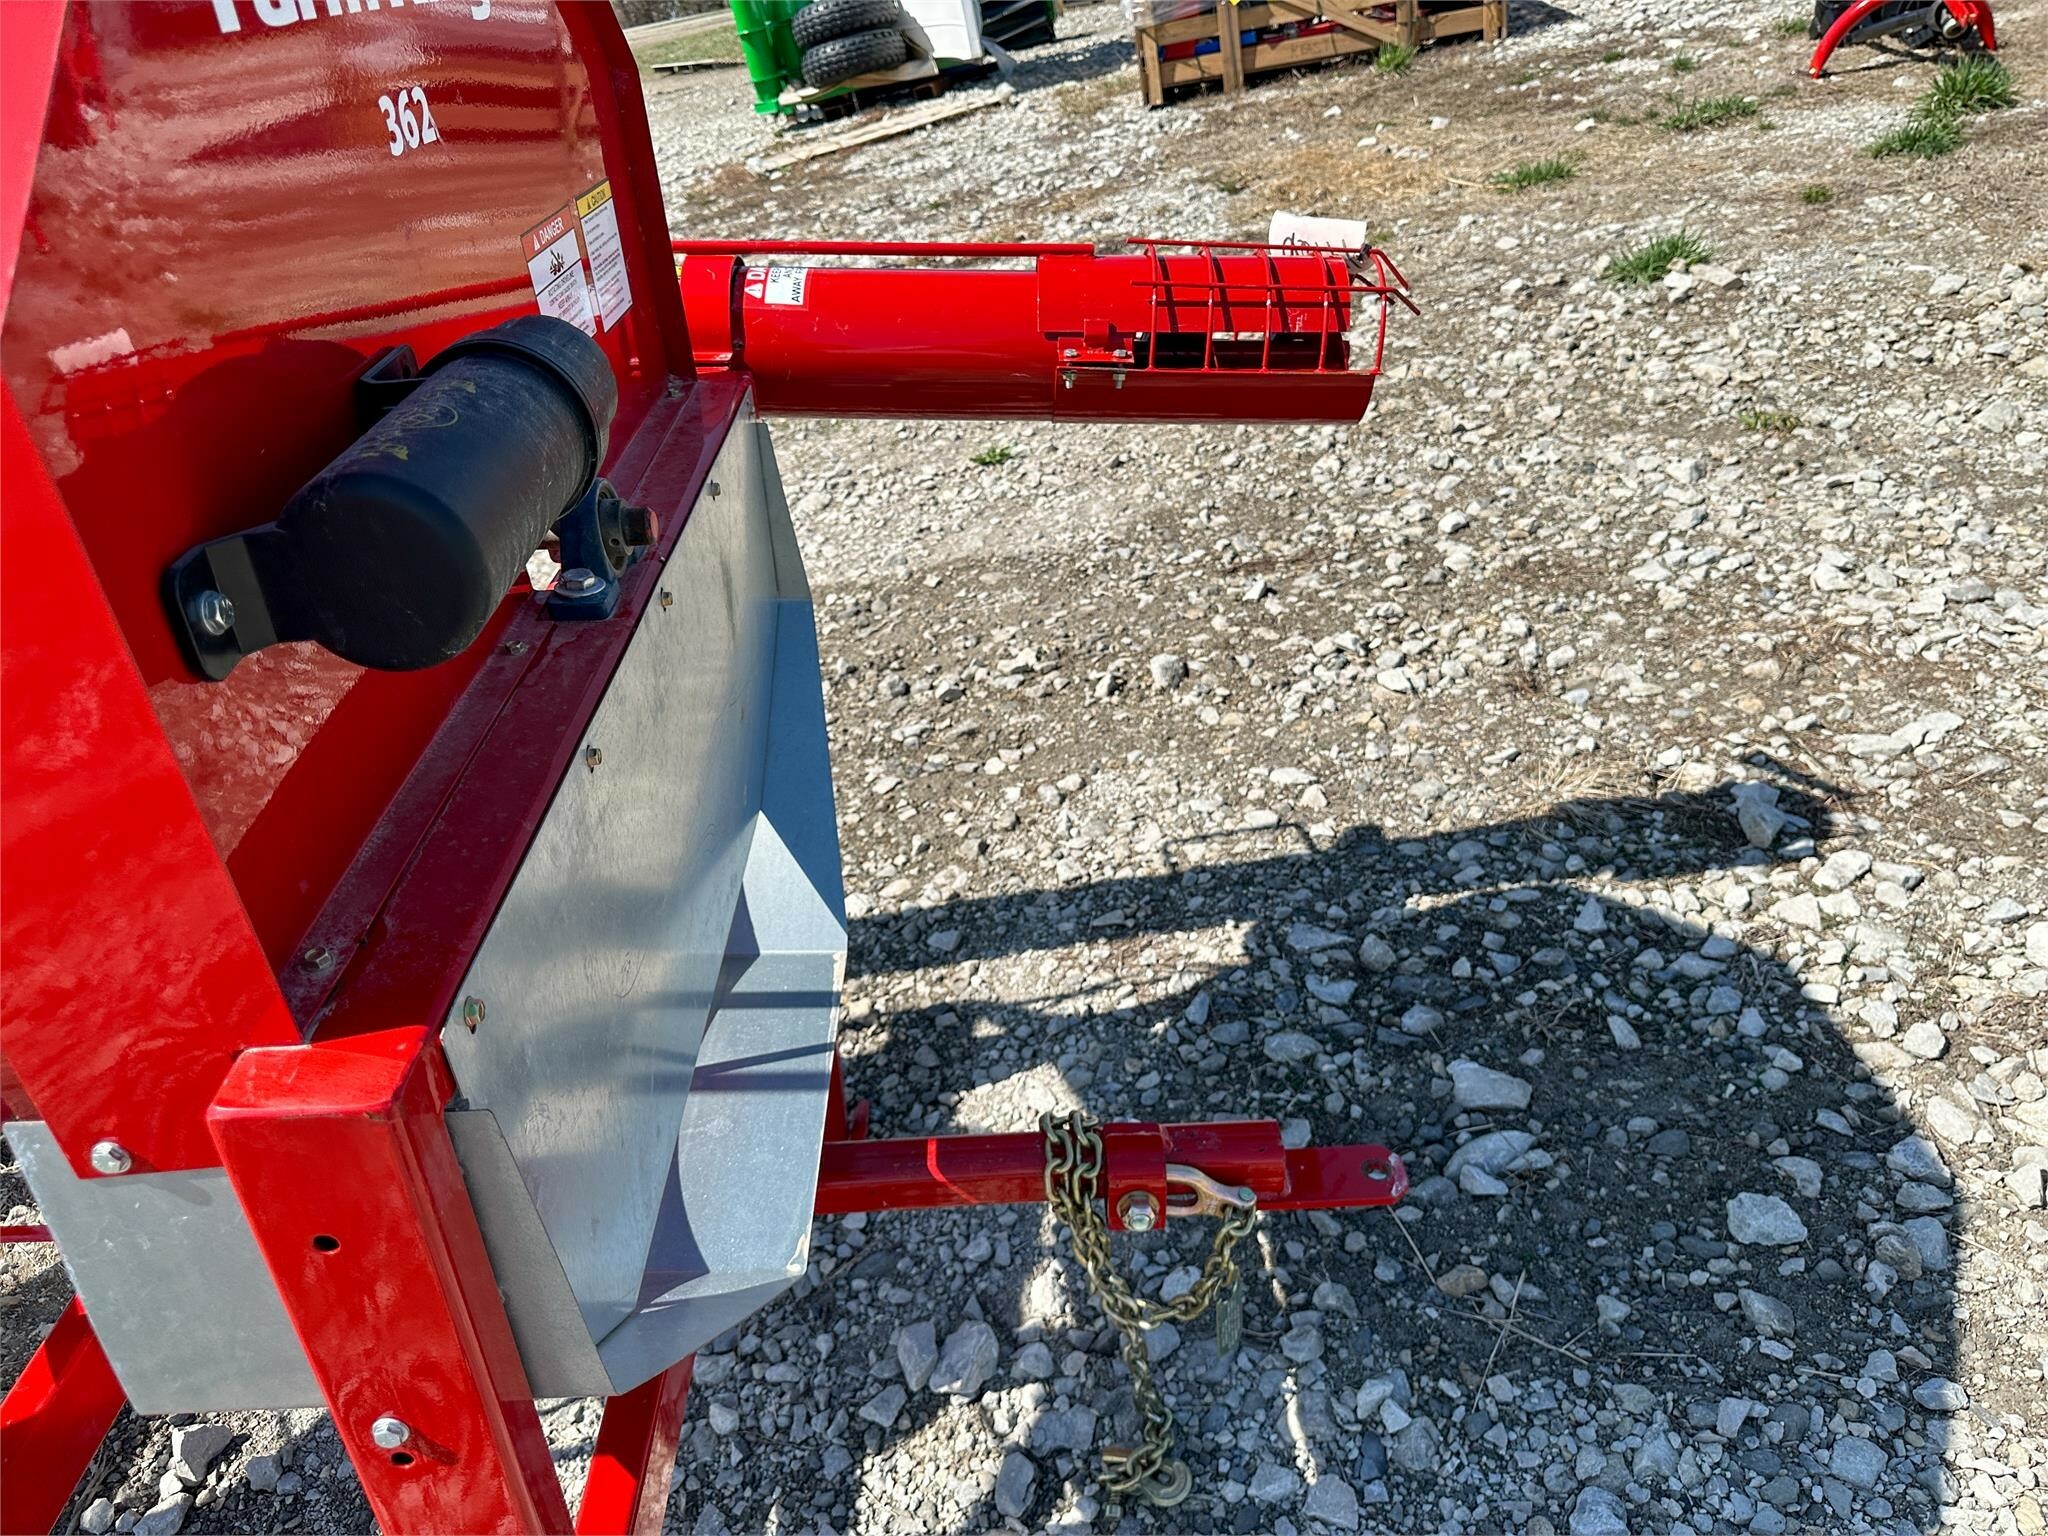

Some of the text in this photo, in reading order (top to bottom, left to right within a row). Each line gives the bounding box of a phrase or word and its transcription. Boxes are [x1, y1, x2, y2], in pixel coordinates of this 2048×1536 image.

[378, 86, 437, 156] 362
[540, 217, 565, 246] DANGER
[791, 277, 801, 303] AWAY
